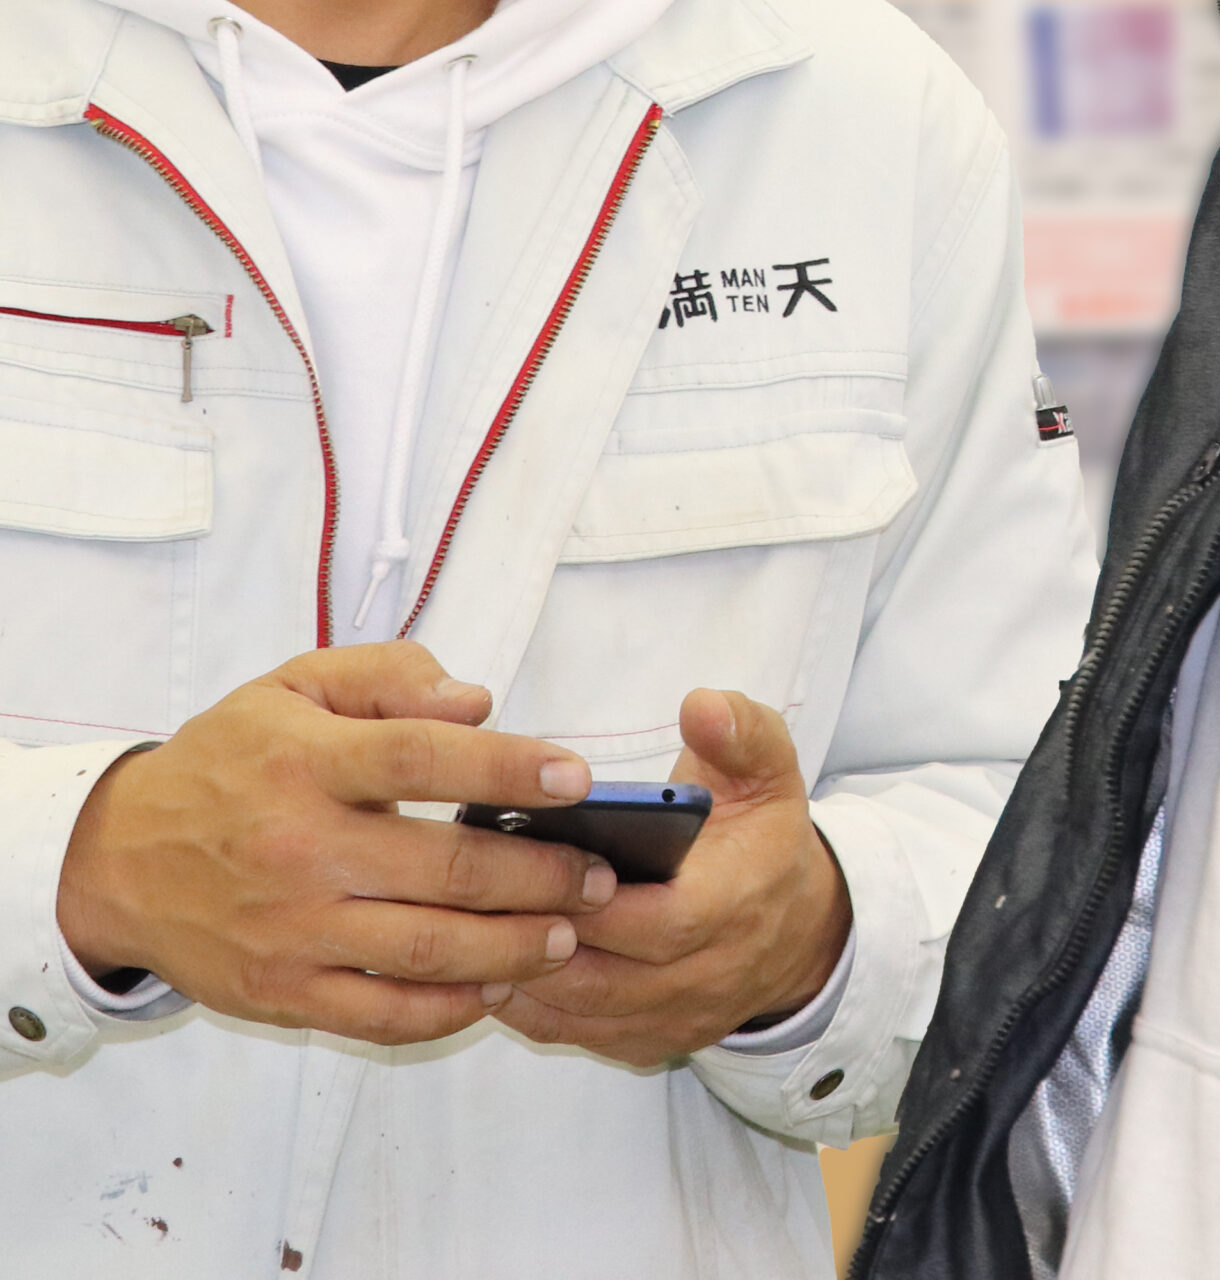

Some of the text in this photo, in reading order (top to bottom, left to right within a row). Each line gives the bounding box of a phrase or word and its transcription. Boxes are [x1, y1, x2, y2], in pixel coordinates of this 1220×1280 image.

[721, 268, 767, 290] MAN
[659, 257, 838, 330] 満 天
[726, 294, 770, 314] TEN
